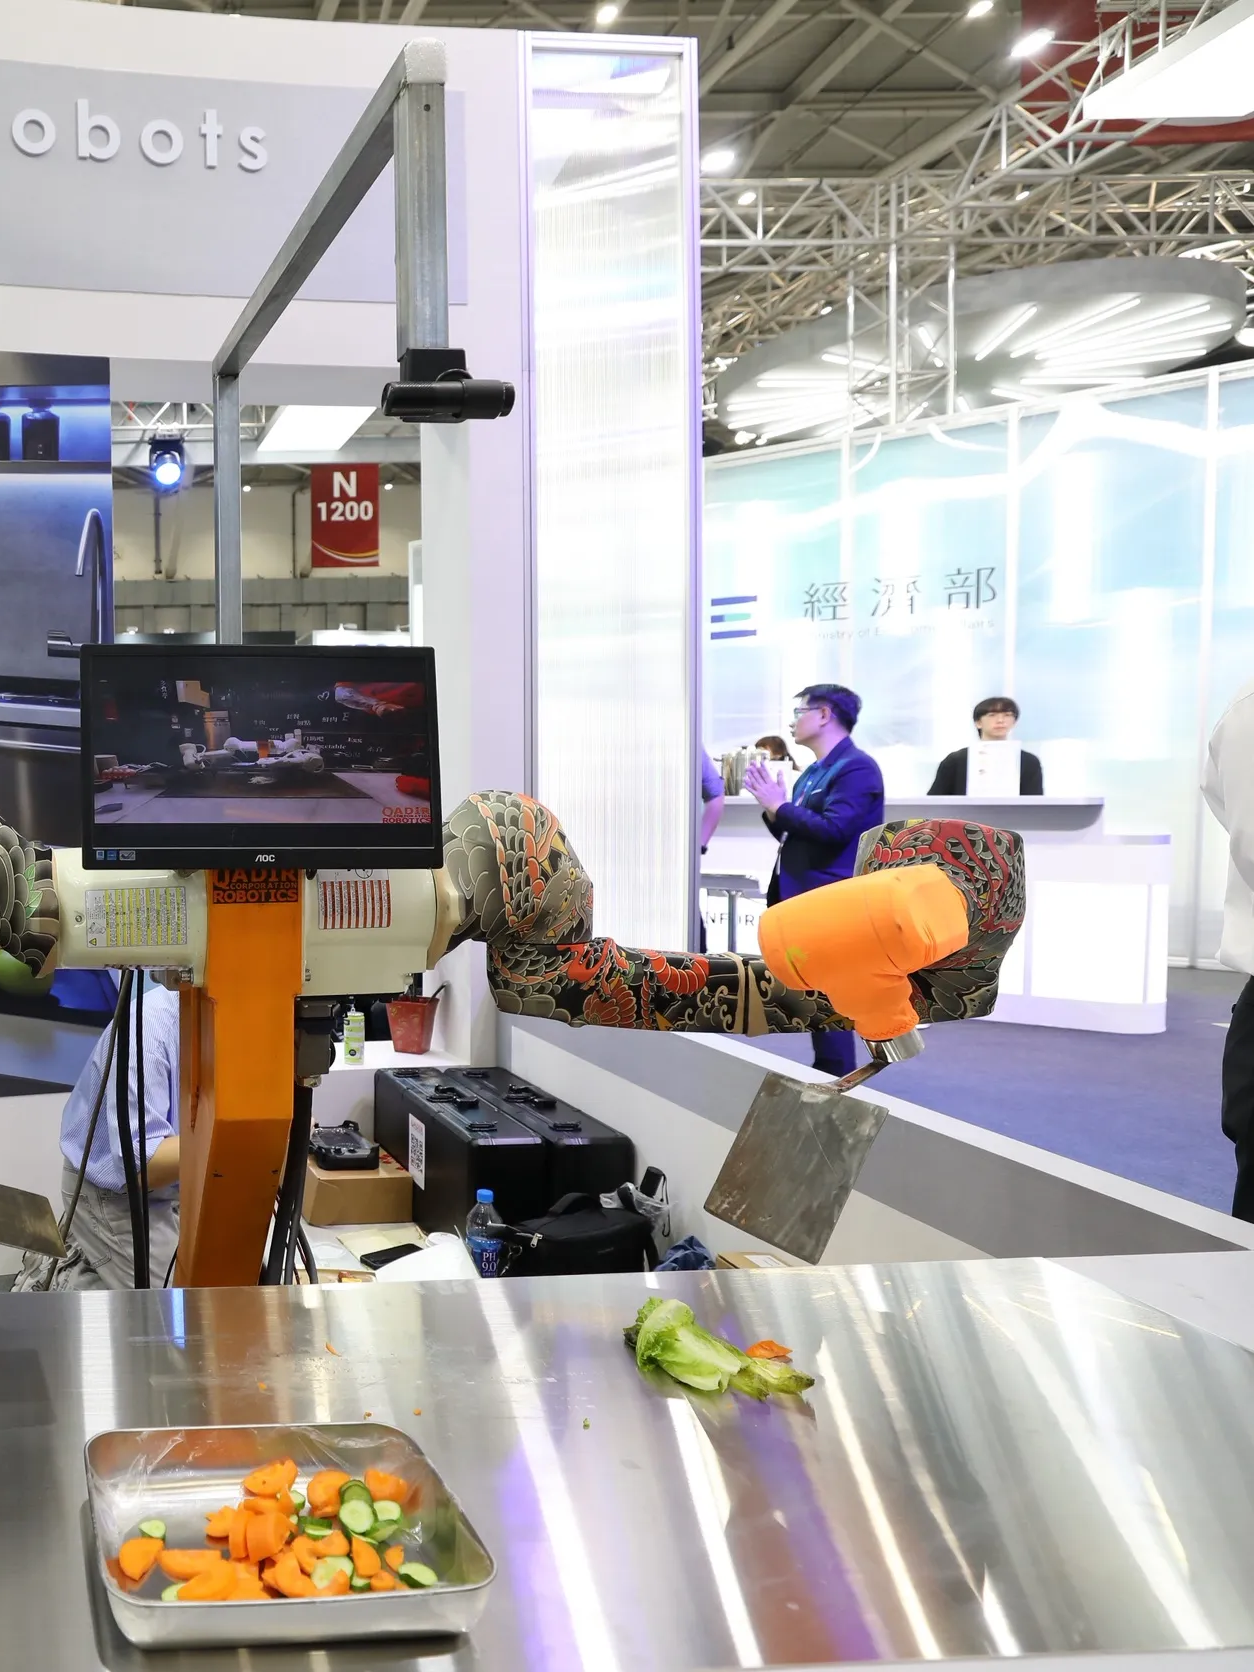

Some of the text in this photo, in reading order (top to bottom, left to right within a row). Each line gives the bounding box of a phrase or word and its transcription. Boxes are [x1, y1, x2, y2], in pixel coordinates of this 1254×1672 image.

[333, 471, 357, 498] N
[317, 500, 374, 522] 1200
[803, 566, 998, 622] 經濟部
[255, 854, 276, 863] AOC
[230, 882, 298, 890] CORPORATION
[213, 889, 299, 903] ROBOTICS
[483, 1252, 496, 1262] PH
